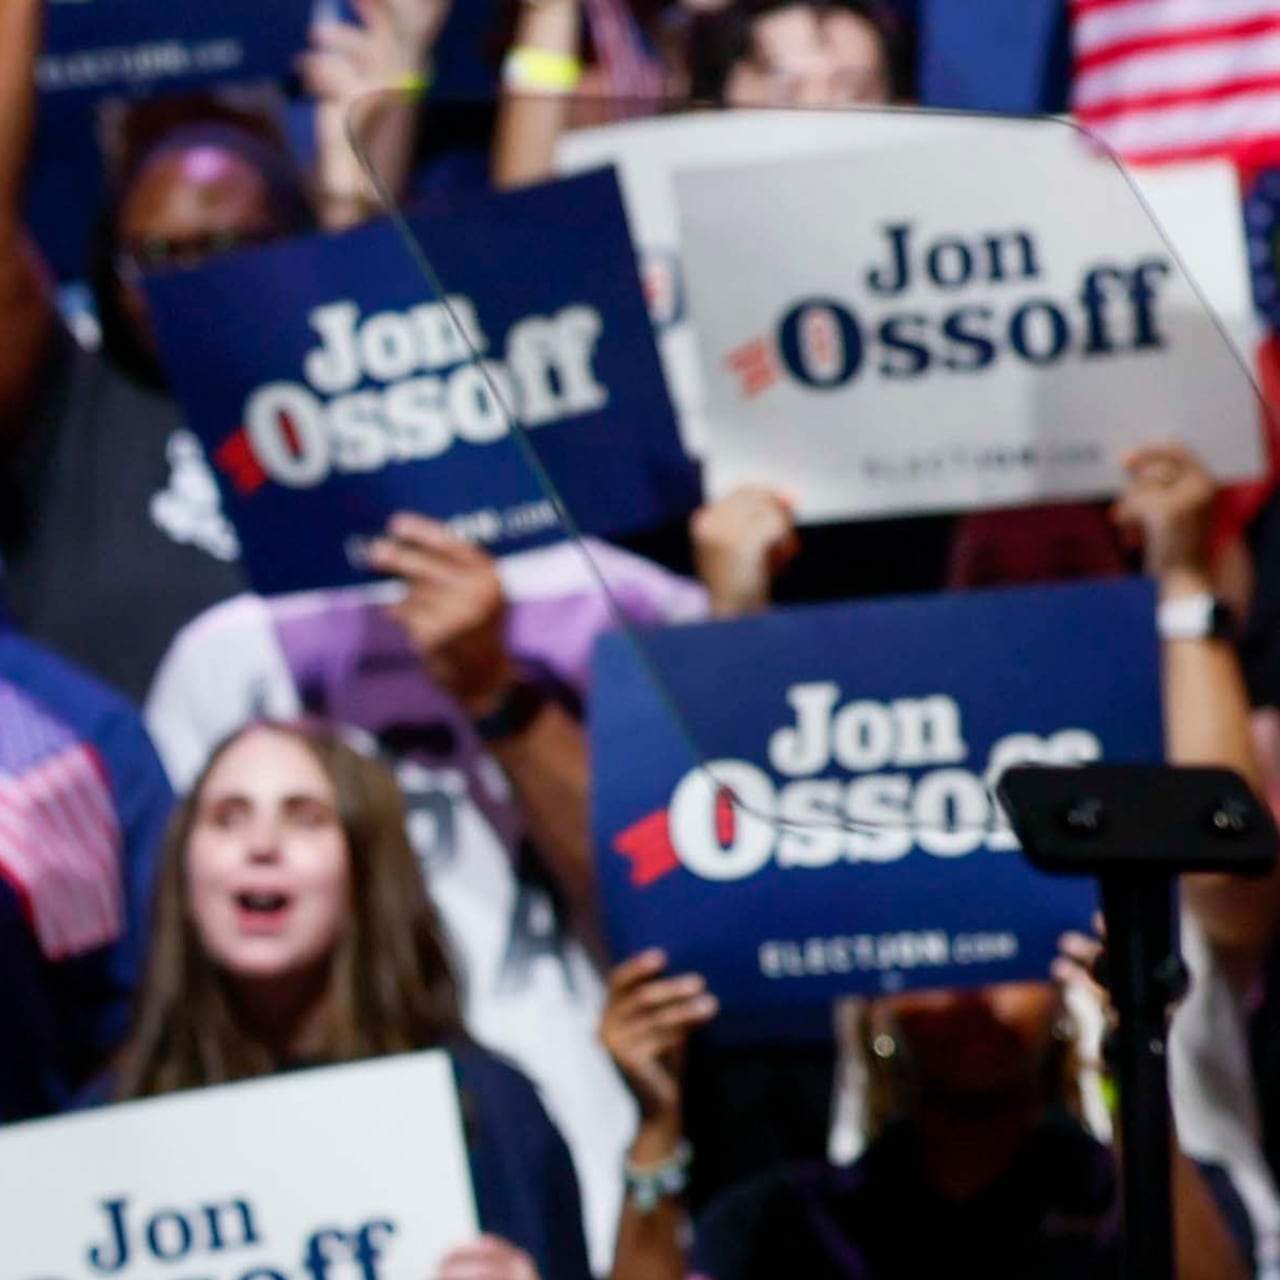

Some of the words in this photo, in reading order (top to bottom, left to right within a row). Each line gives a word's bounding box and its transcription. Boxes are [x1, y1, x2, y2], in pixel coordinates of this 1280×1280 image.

[864, 222, 1041, 297] Jon
[302, 296, 486, 392] Jon
[774, 258, 1169, 392] Ossoff
[242, 302, 608, 488] Ossoff
[766, 681, 968, 778] Jon
[86, 1194, 262, 1274] Jon
